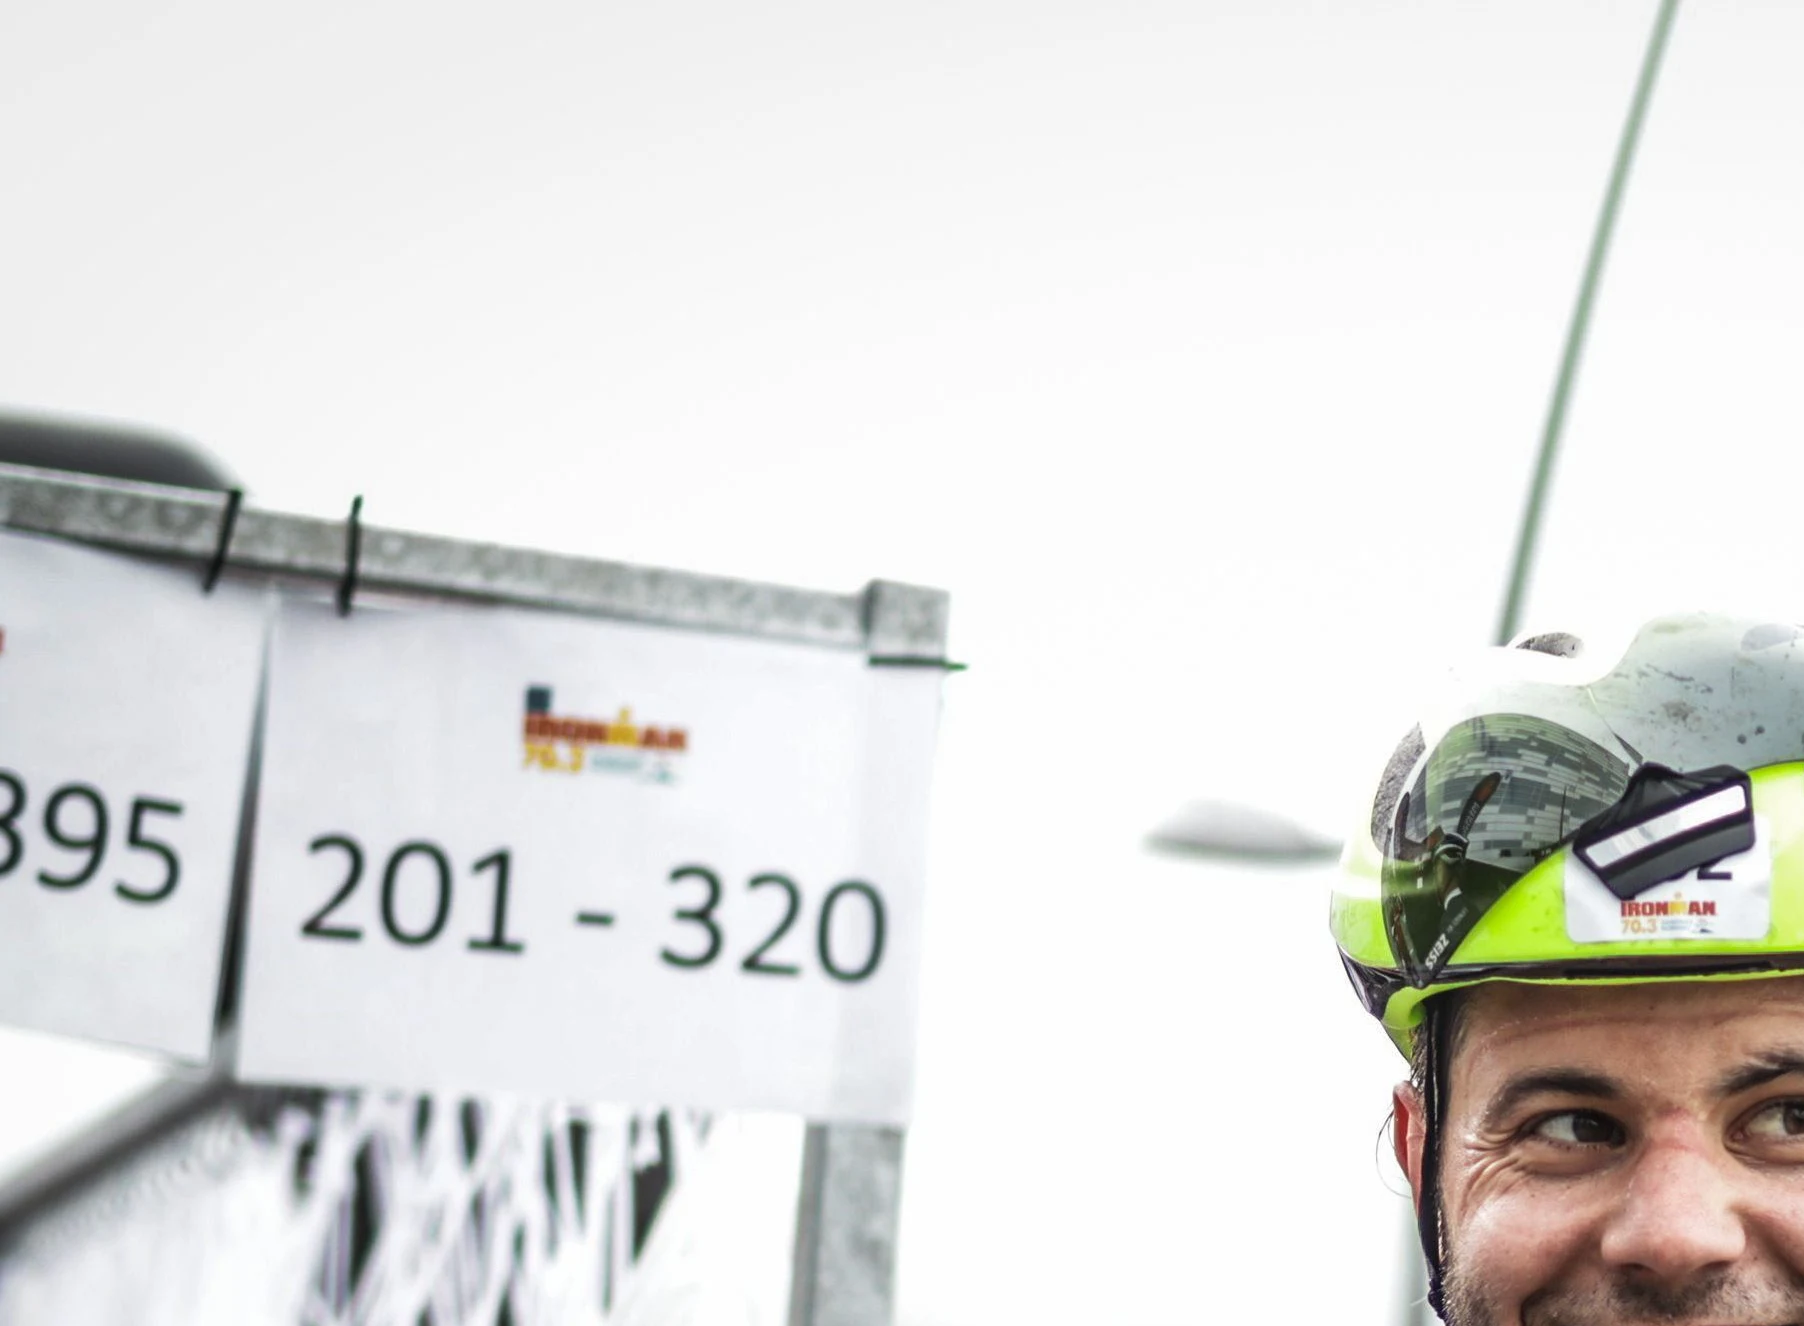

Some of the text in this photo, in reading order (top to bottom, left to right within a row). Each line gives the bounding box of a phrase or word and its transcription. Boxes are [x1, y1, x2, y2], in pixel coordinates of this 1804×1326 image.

[301, 833, 889, 985] 201 - 320
[1620, 893, 1717, 917] IRONMAN
[1621, 919, 1658, 934] 70.3
[1425, 933, 1450, 970] ZEISS
